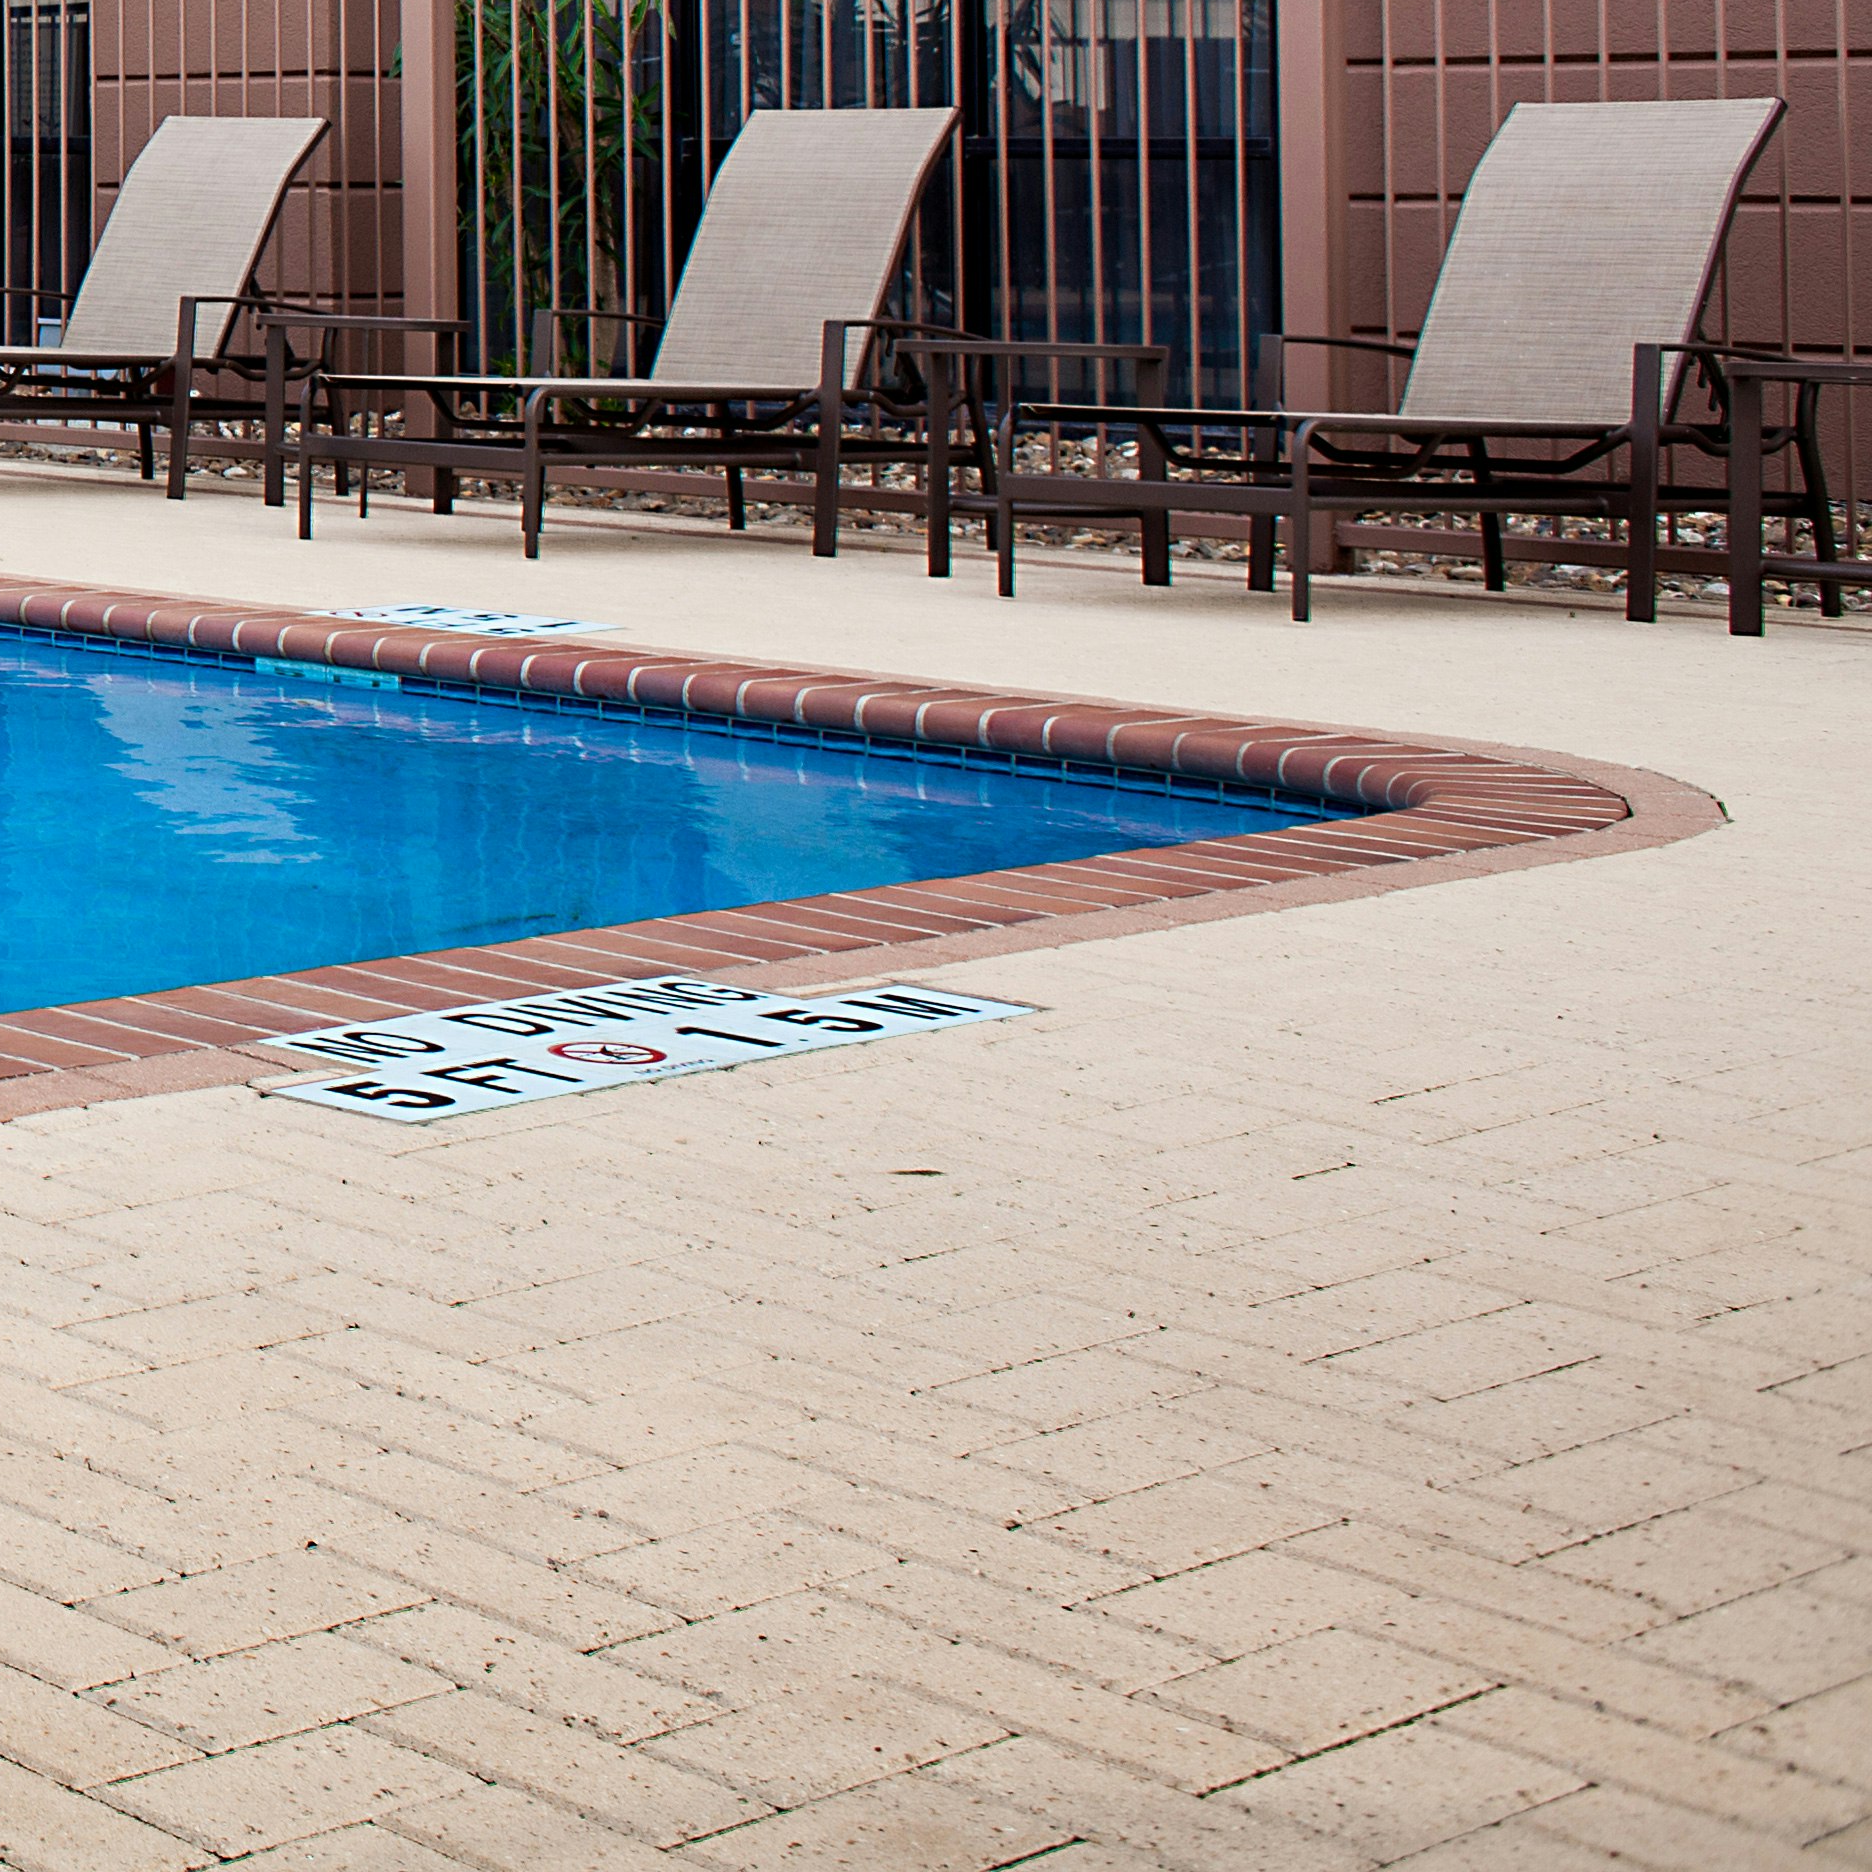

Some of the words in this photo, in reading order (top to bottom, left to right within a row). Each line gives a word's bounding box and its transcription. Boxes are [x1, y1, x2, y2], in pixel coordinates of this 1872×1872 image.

[287, 1030, 446, 1063] NO
[440, 982, 767, 1037] DIVING
[322, 1080, 456, 1109] 5
[420, 1057, 584, 1094] FT
[675, 1008, 885, 1047] 1.5
[840, 993, 982, 1020] M
